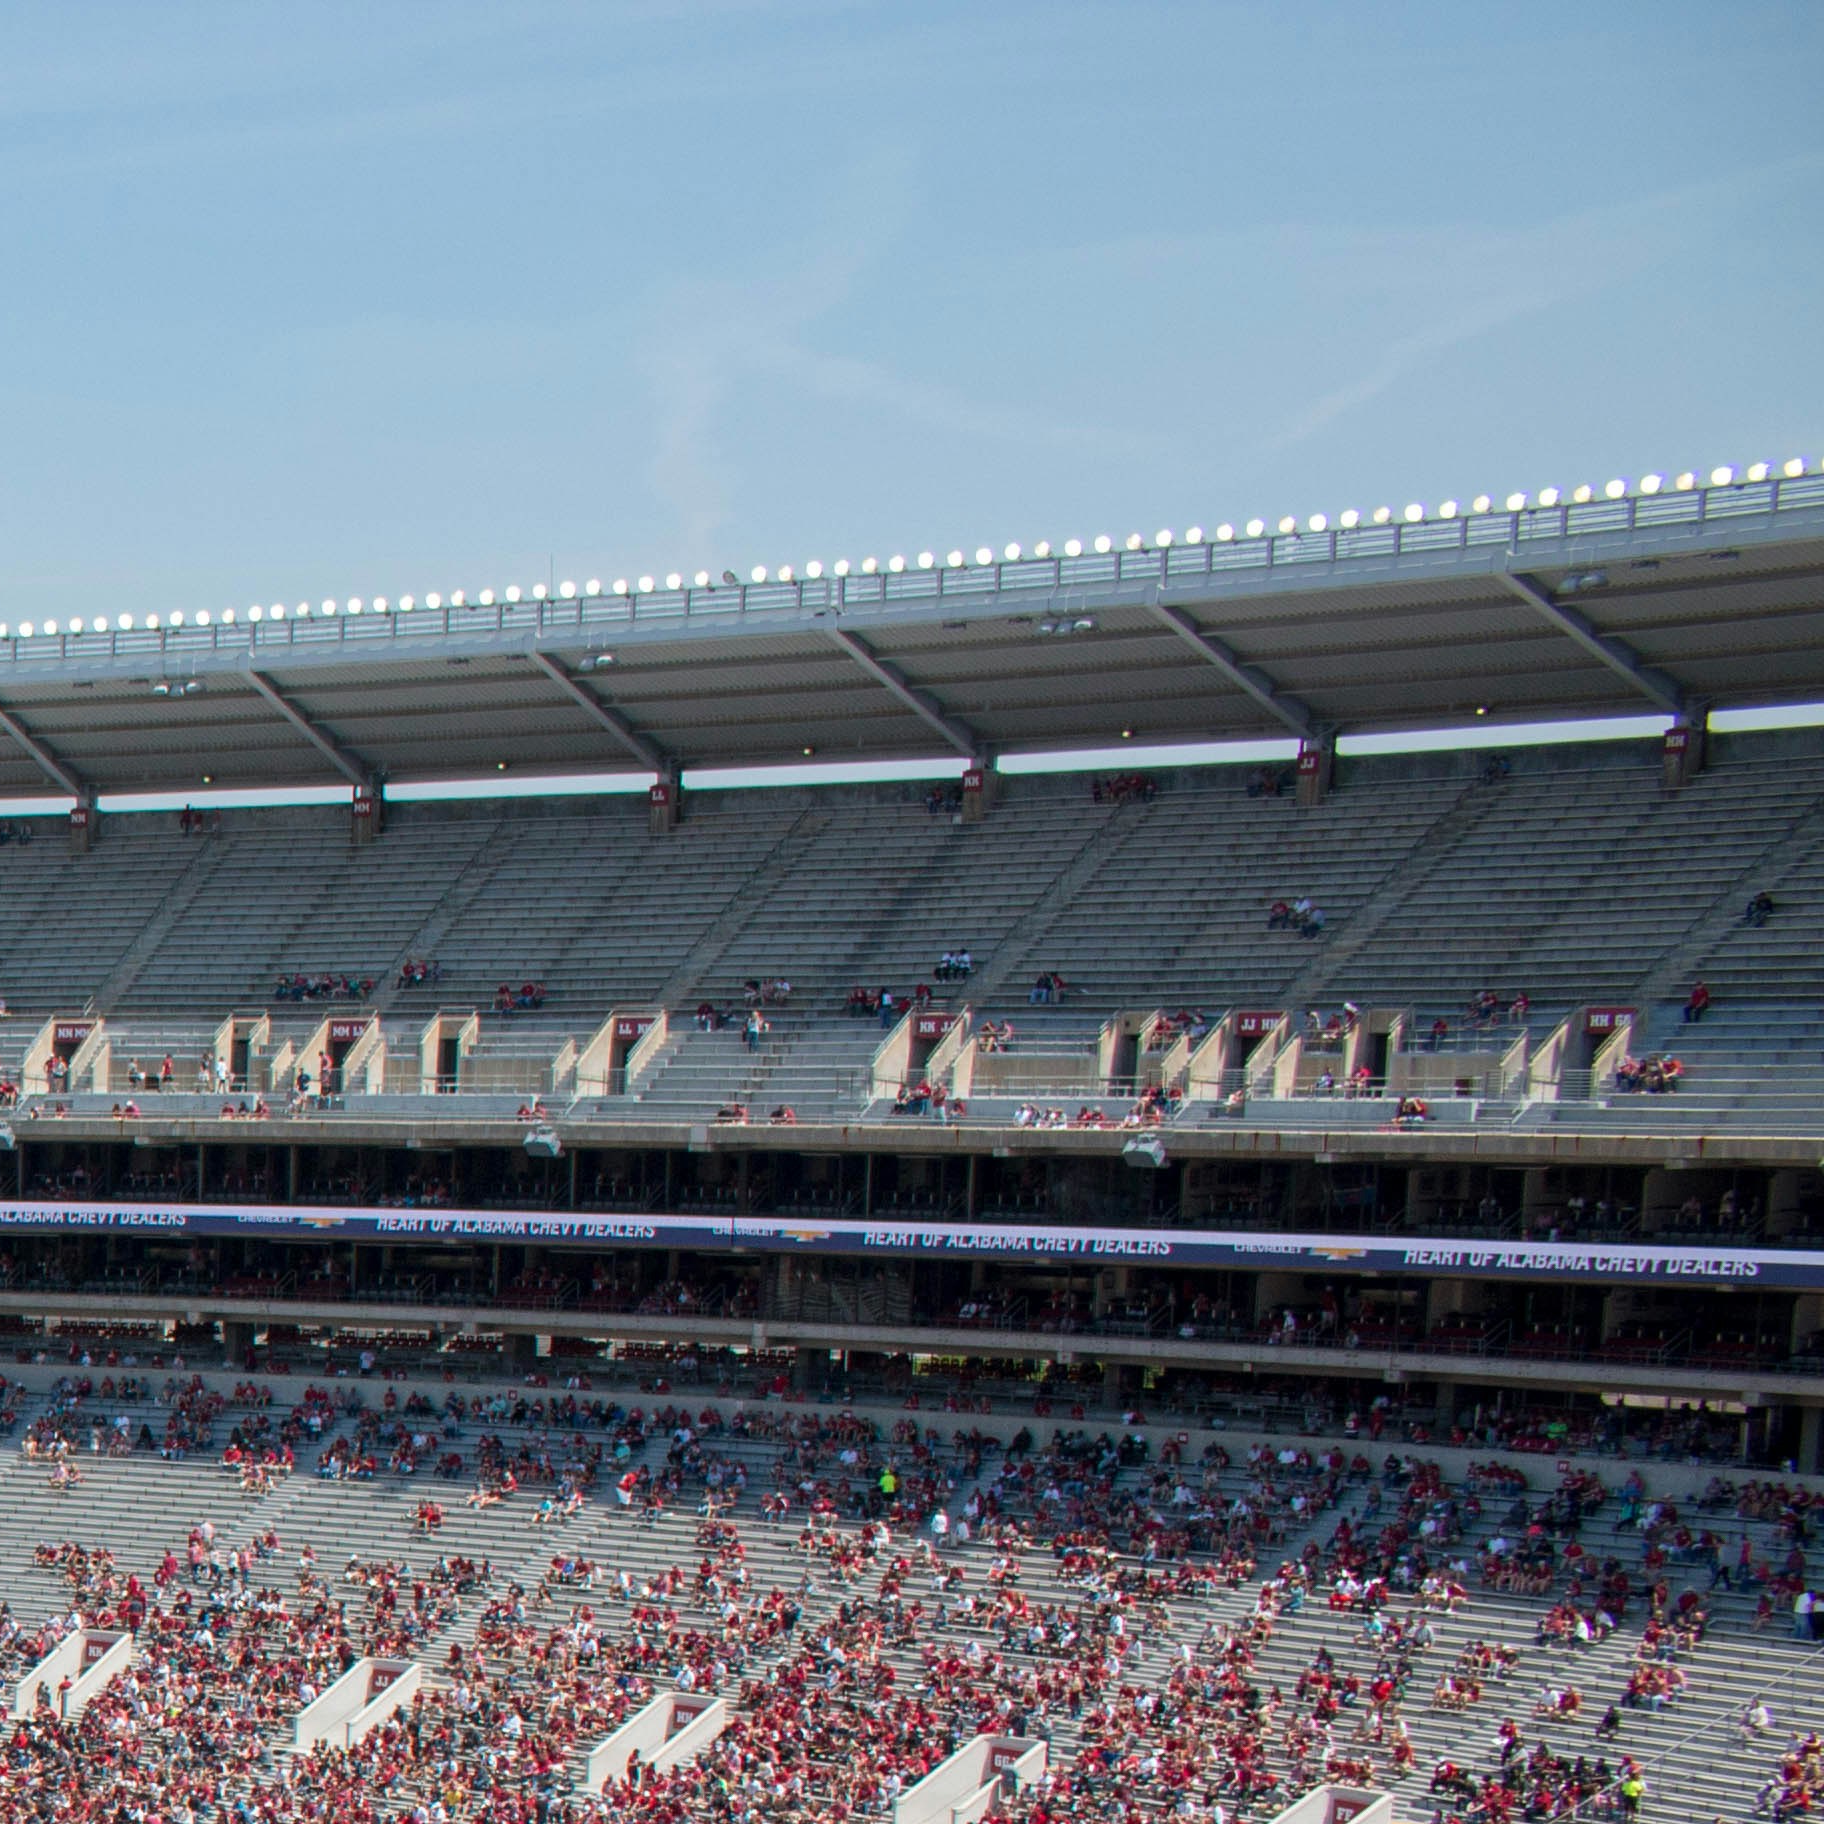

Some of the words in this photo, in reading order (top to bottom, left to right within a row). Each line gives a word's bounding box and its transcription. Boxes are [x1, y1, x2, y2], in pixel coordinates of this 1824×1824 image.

[67, 1211, 121, 1225] CHEVY
[120, 1212, 188, 1226] DEALERS
[376, 1218, 428, 1231] HEART
[431, 1219, 452, 1232] OF
[452, 1219, 526, 1234] ALABAMA
[529, 1221, 585, 1235] CHEVY
[585, 1223, 656, 1237] DEALERS
[863, 1231, 917, 1245] HEART
[921, 1232, 943, 1246] OF
[946, 1235, 1030, 1250] ALABAMA
[1033, 1235, 1090, 1251] CHEVY
[1092, 1238, 1170, 1254] DEALERS
[1404, 1249, 1464, 1265] HEART
[1468, 1251, 1493, 1266] OF
[1496, 1253, 1591, 1269] ALABAMA
[1593, 1255, 1661, 1272] CHEVY
[1666, 1258, 1760, 1276] DEALERS
